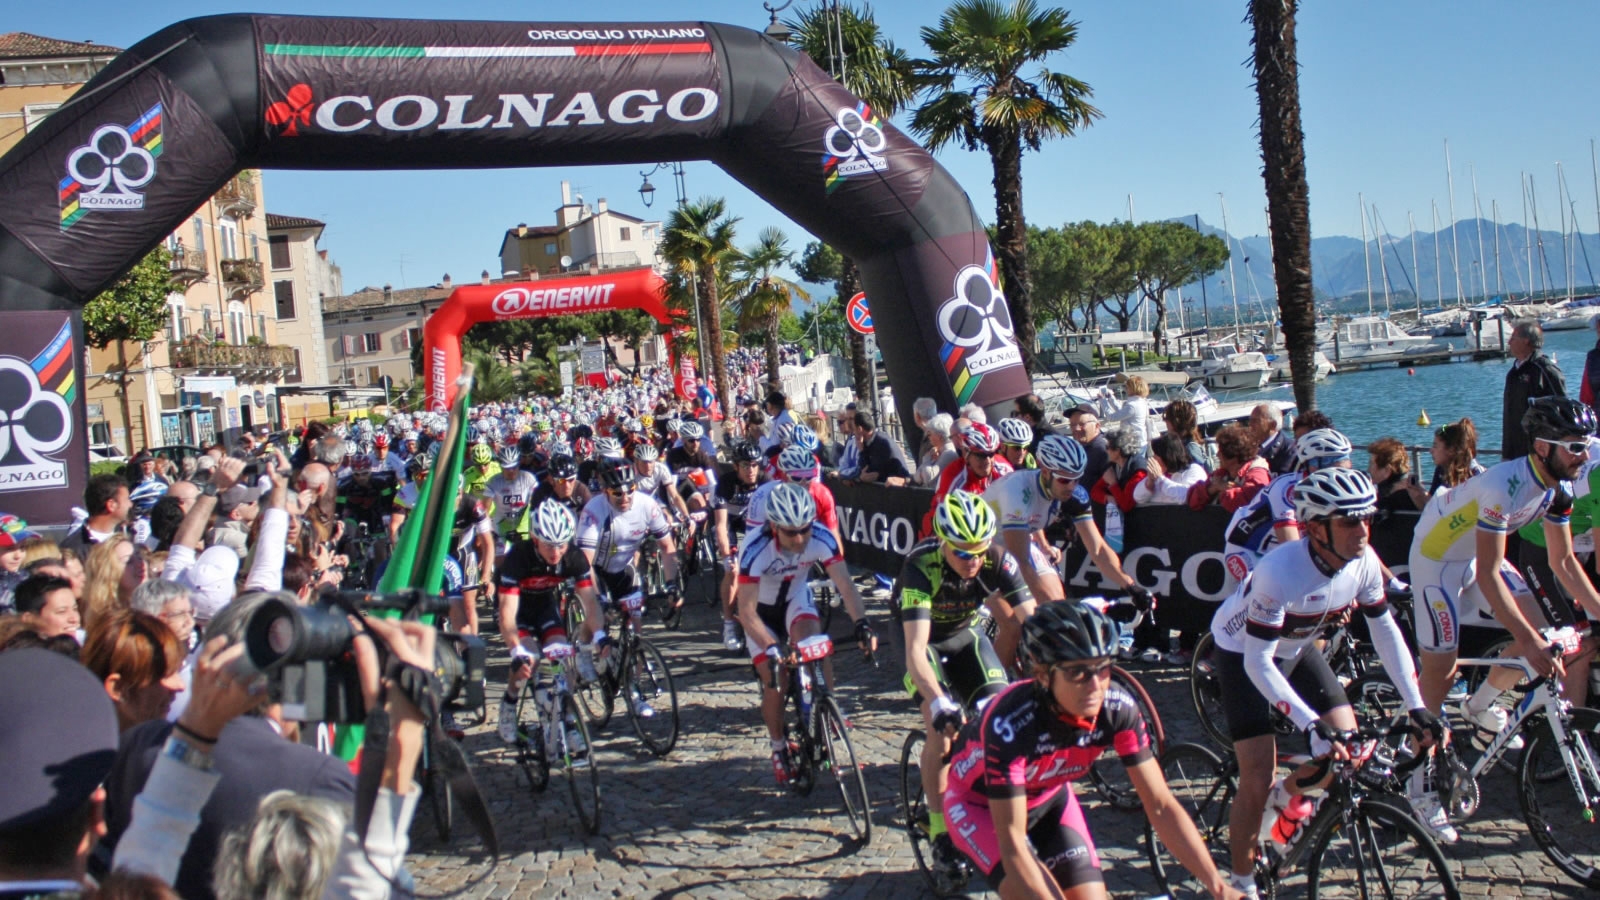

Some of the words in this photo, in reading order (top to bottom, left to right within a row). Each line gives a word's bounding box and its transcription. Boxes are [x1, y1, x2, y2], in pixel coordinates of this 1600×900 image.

[528, 29, 625, 40] ORGOGLIO
[628, 27, 706, 40] ITALIANO
[315, 87, 719, 132] COLNAGO
[80, 197, 142, 205] COLNAGO
[528, 283, 616, 311] ENERVIT
[969, 350, 1019, 370] COLNAG
[804, 643, 829, 659] 151
